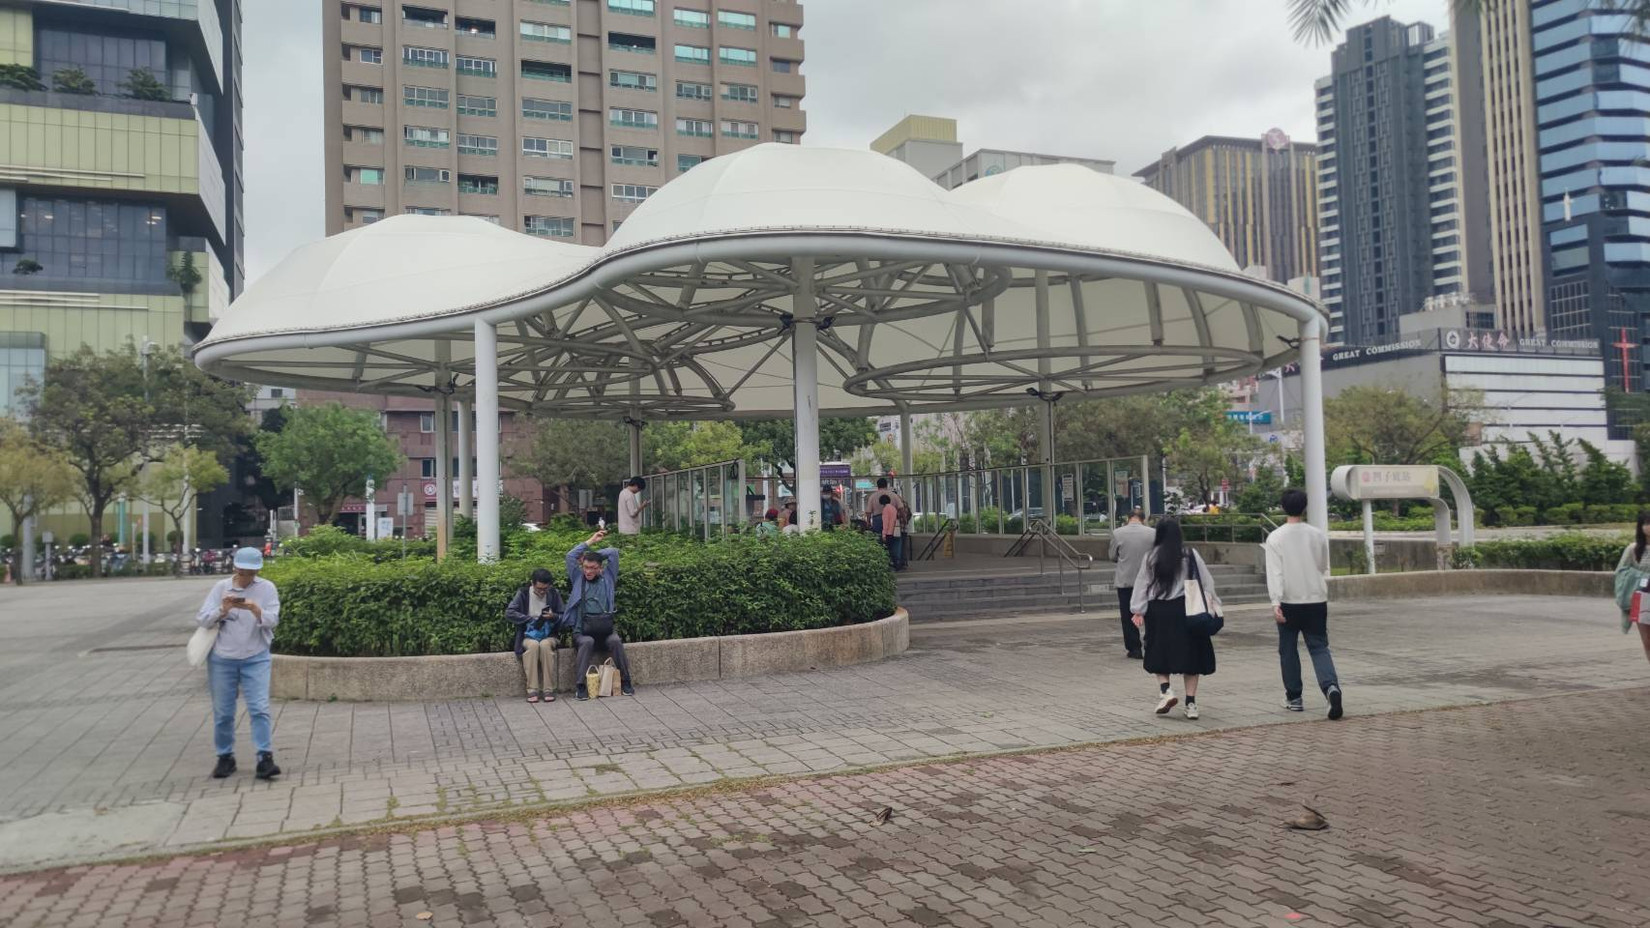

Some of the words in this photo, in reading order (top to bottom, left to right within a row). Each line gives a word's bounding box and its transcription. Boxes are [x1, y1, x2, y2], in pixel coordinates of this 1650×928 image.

[1467, 331, 1510, 349] 大使命
[1519, 338, 1546, 347] GREAT
[1551, 339, 1599, 349] COMMISSION
[1332, 350, 1361, 361] GREAT
[1366, 339, 1422, 356] COMMISSION
